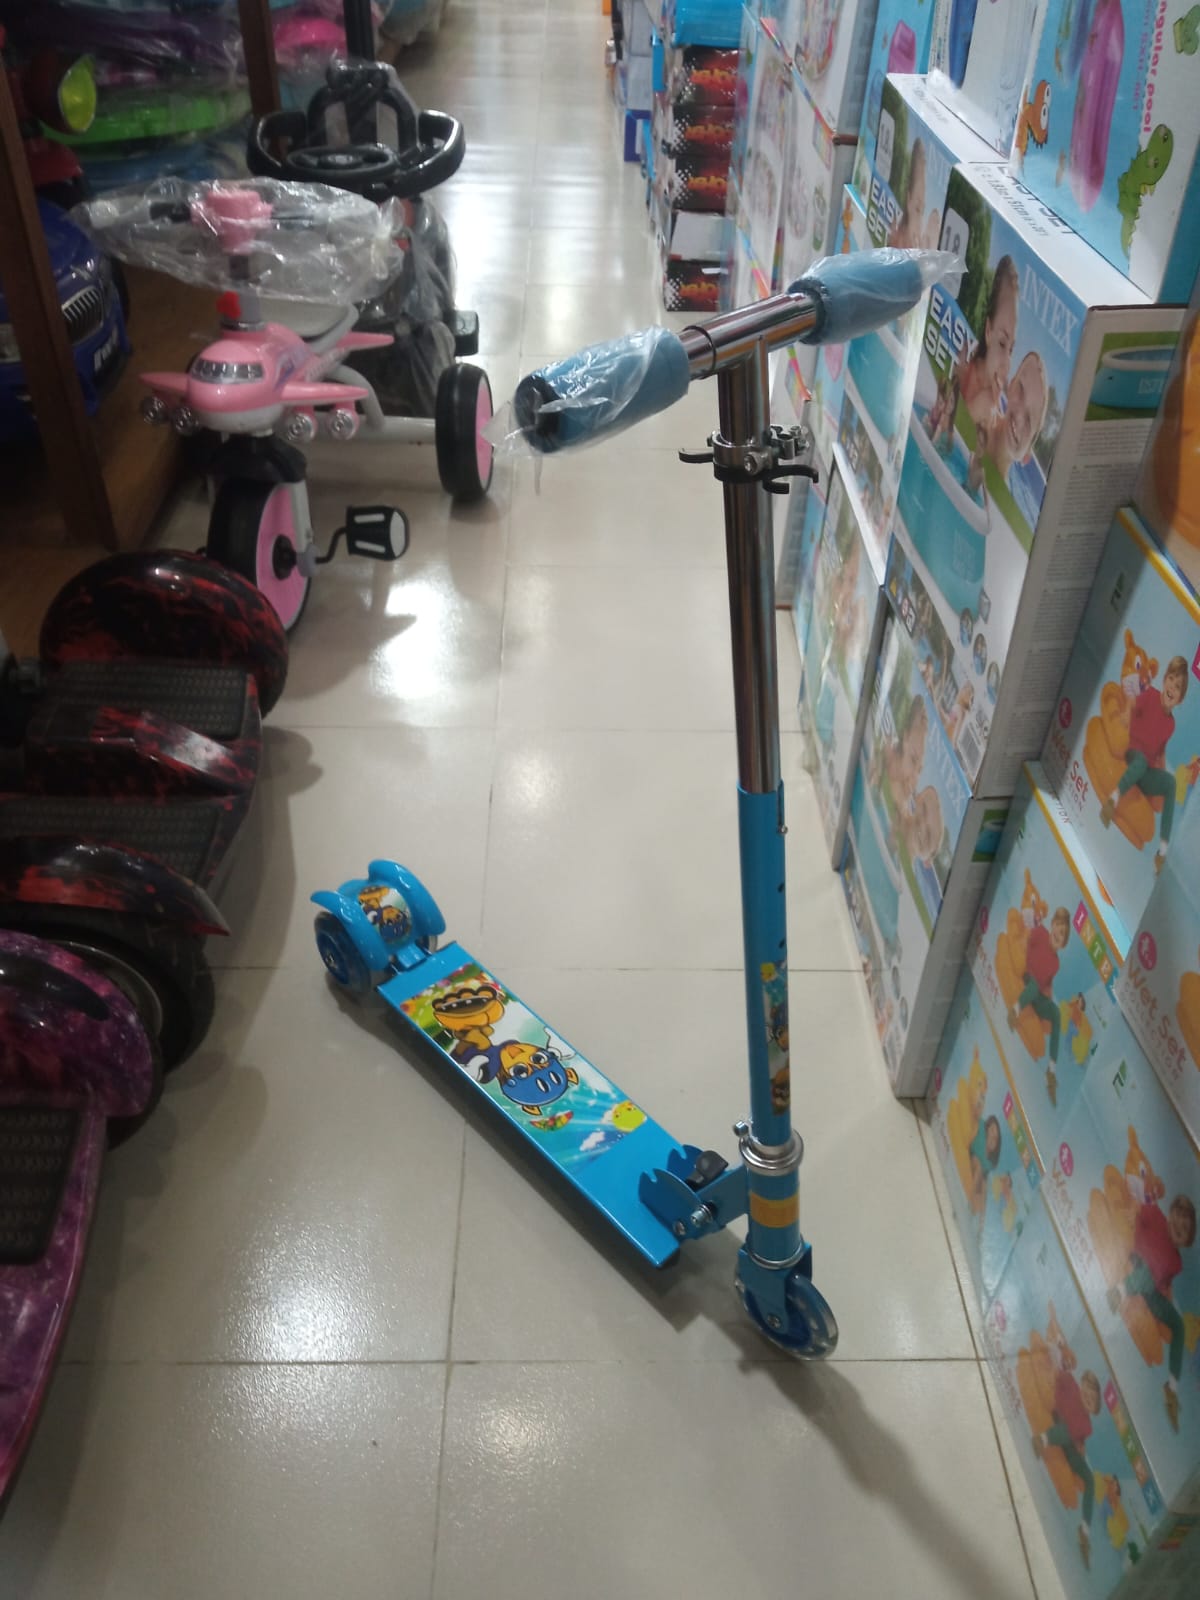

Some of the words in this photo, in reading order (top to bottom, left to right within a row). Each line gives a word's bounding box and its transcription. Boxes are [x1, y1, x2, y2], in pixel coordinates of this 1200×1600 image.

[1143, 83, 1155, 132] pool
[871, 178, 904, 230] EASY
[929, 289, 980, 362] EASY
[1020, 264, 1079, 358] INTEX
[924, 322, 960, 380] SET
[928, 720, 962, 818] INTEX
[1070, 760, 1089, 802] Set
[1128, 955, 1158, 1020] Wet
[1158, 1014, 1187, 1073] Set
